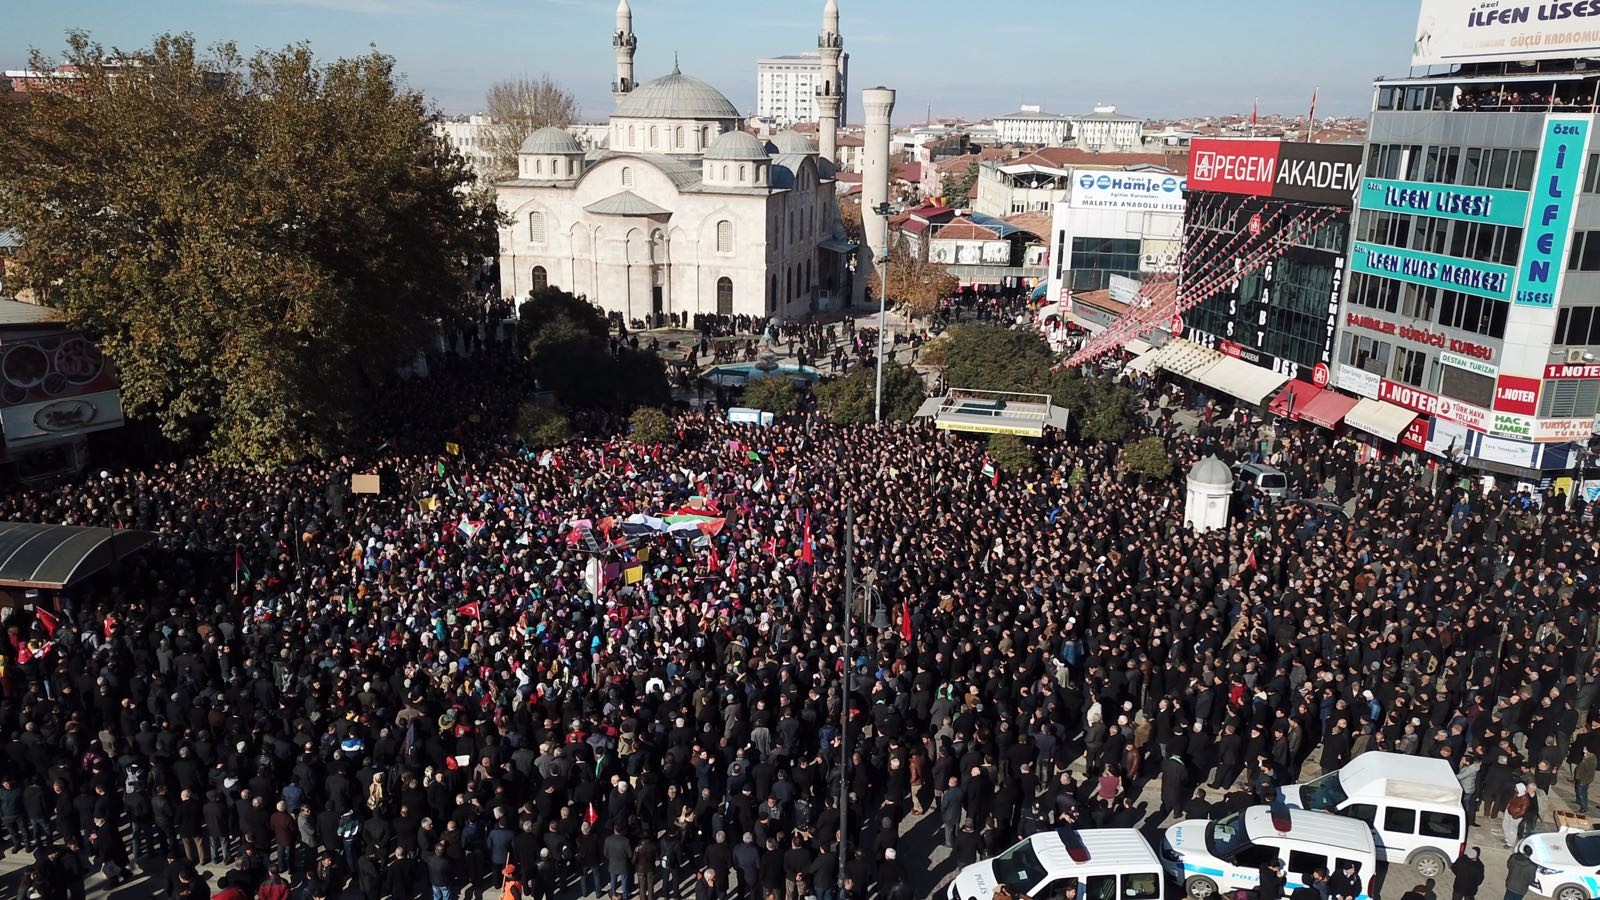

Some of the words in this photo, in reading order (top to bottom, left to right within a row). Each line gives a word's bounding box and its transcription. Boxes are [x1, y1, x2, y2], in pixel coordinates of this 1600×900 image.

[1468, 7, 1530, 27] İLFEN
[1510, 32, 1541, 48] GÜÇLÜ
[1544, 30, 1600, 45] KADROMU
[1553, 124, 1579, 135] ÖZEL
[1214, 155, 1274, 183] PEGEM
[1121, 201, 1158, 209] ANADOLU
[1385, 186, 1431, 210] İLFEN
[1436, 191, 1493, 217] LİSESİ
[1528, 144, 1567, 283] İLFEN
[1367, 250, 1401, 272] İLFEN
[1403, 257, 1438, 279] KURS
[1441, 264, 1507, 293] MERKEZİ
[1517, 291, 1553, 304] LİSESİ
[1322, 257, 1344, 362] MATEMATİK
[1188, 328, 1215, 349] ALES
[1399, 325, 1445, 348] SÜRÜCÜ
[1449, 339, 1493, 360] KURSU
[1273, 357, 1298, 379] DGS
[1442, 354, 1467, 367] DESTAN
[1469, 361, 1496, 375] TURİZM
[1381, 382, 1438, 413] 1.NOTER
[1497, 387, 1536, 403] 1.NOTER
[1470, 409, 1485, 420] HAVA
[1495, 415, 1520, 425] HAC
[1494, 424, 1530, 434] UMRE
